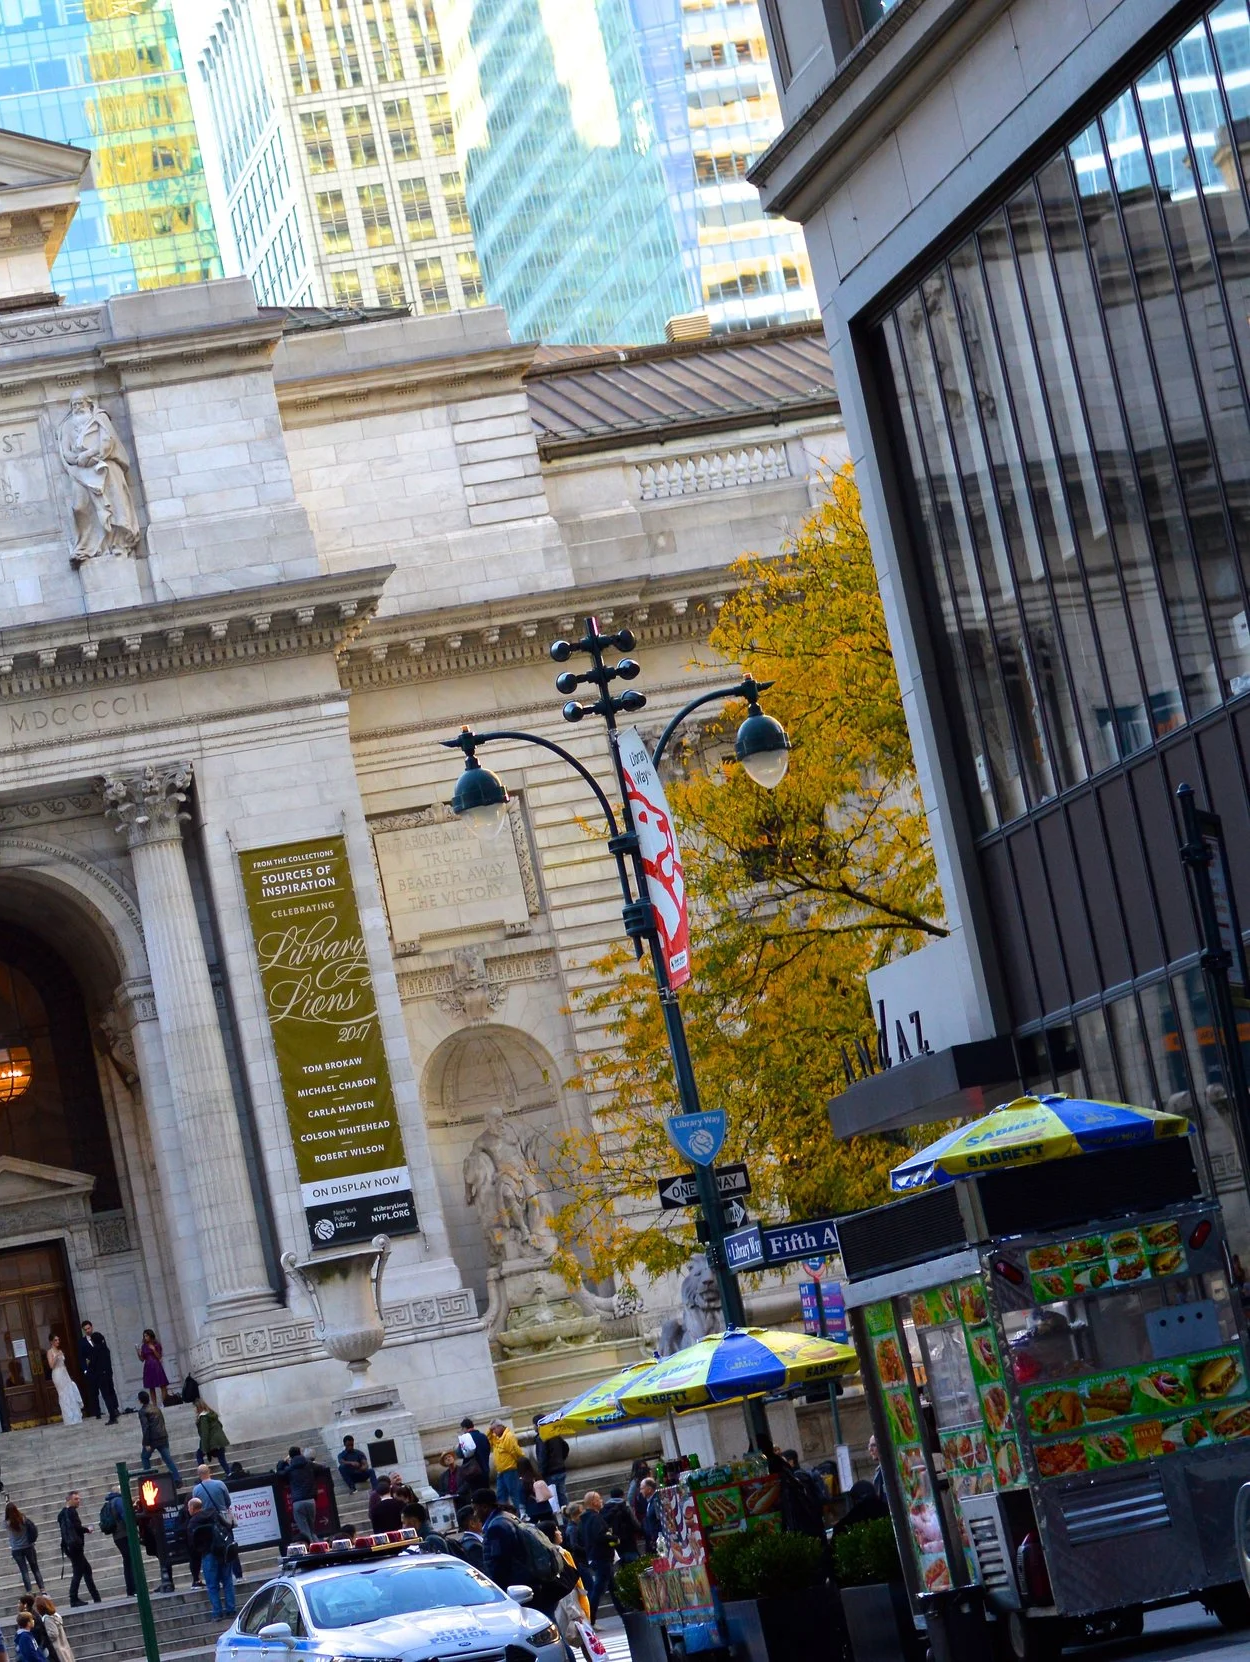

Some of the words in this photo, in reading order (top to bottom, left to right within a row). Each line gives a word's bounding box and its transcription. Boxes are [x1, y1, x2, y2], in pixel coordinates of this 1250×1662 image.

[3, 492, 21, 504] OF
[9, 692, 151, 734] MDCCCCII
[404, 831, 441, 847] ABOVE
[253, 860, 272, 869] FROM
[274, 857, 286, 865] THE
[288, 849, 334, 863] COLLECTIONS
[422, 847, 472, 868] TRUTH
[261, 868, 313, 885] SOURCES
[316, 865, 331, 876] OF
[398, 868, 460, 892] BEARETH
[467, 861, 506, 877] AWAY
[262, 877, 336, 898] INSPIRATION
[408, 894, 437, 910] THE
[441, 881, 505, 904] VICTORY
[271, 901, 335, 918] CELEBRATING
[258, 915, 372, 990] Library
[269, 973, 377, 1025] Lions
[337, 1022, 371, 1043] 2017
[302, 1064, 323, 1074] TOM
[324, 1057, 362, 1070] BROKAW
[297, 1084, 337, 1098] MICHAEL
[338, 1077, 377, 1090] CHABON
[307, 1107, 337, 1118] CARLA
[338, 1100, 375, 1113] HAYDEN
[300, 1130, 336, 1142] COLSON
[337, 1120, 391, 1136] WHITEHEAD
[674, 1120, 702, 1131] Library
[703, 1115, 721, 1126] Way
[314, 1150, 348, 1163] ROBERT
[349, 1144, 385, 1157] WILSON
[967, 1144, 1043, 1167] SABRETT
[312, 1189, 329, 1198] ON
[331, 1180, 372, 1195] DISPLAY
[374, 1175, 400, 1187] NOW
[672, 1183, 695, 1198] ONE
[335, 1220, 357, 1229] Library
[371, 1208, 411, 1222] NYPL.ORG
[731, 1243, 750, 1260] Library
[769, 1234, 817, 1254] Fifth
[253, 1500, 270, 1508] York
[245, 1509, 271, 1519] Library
[429, 1630, 491, 1645] POLICE
[435, 1627, 477, 1637] NYPD
